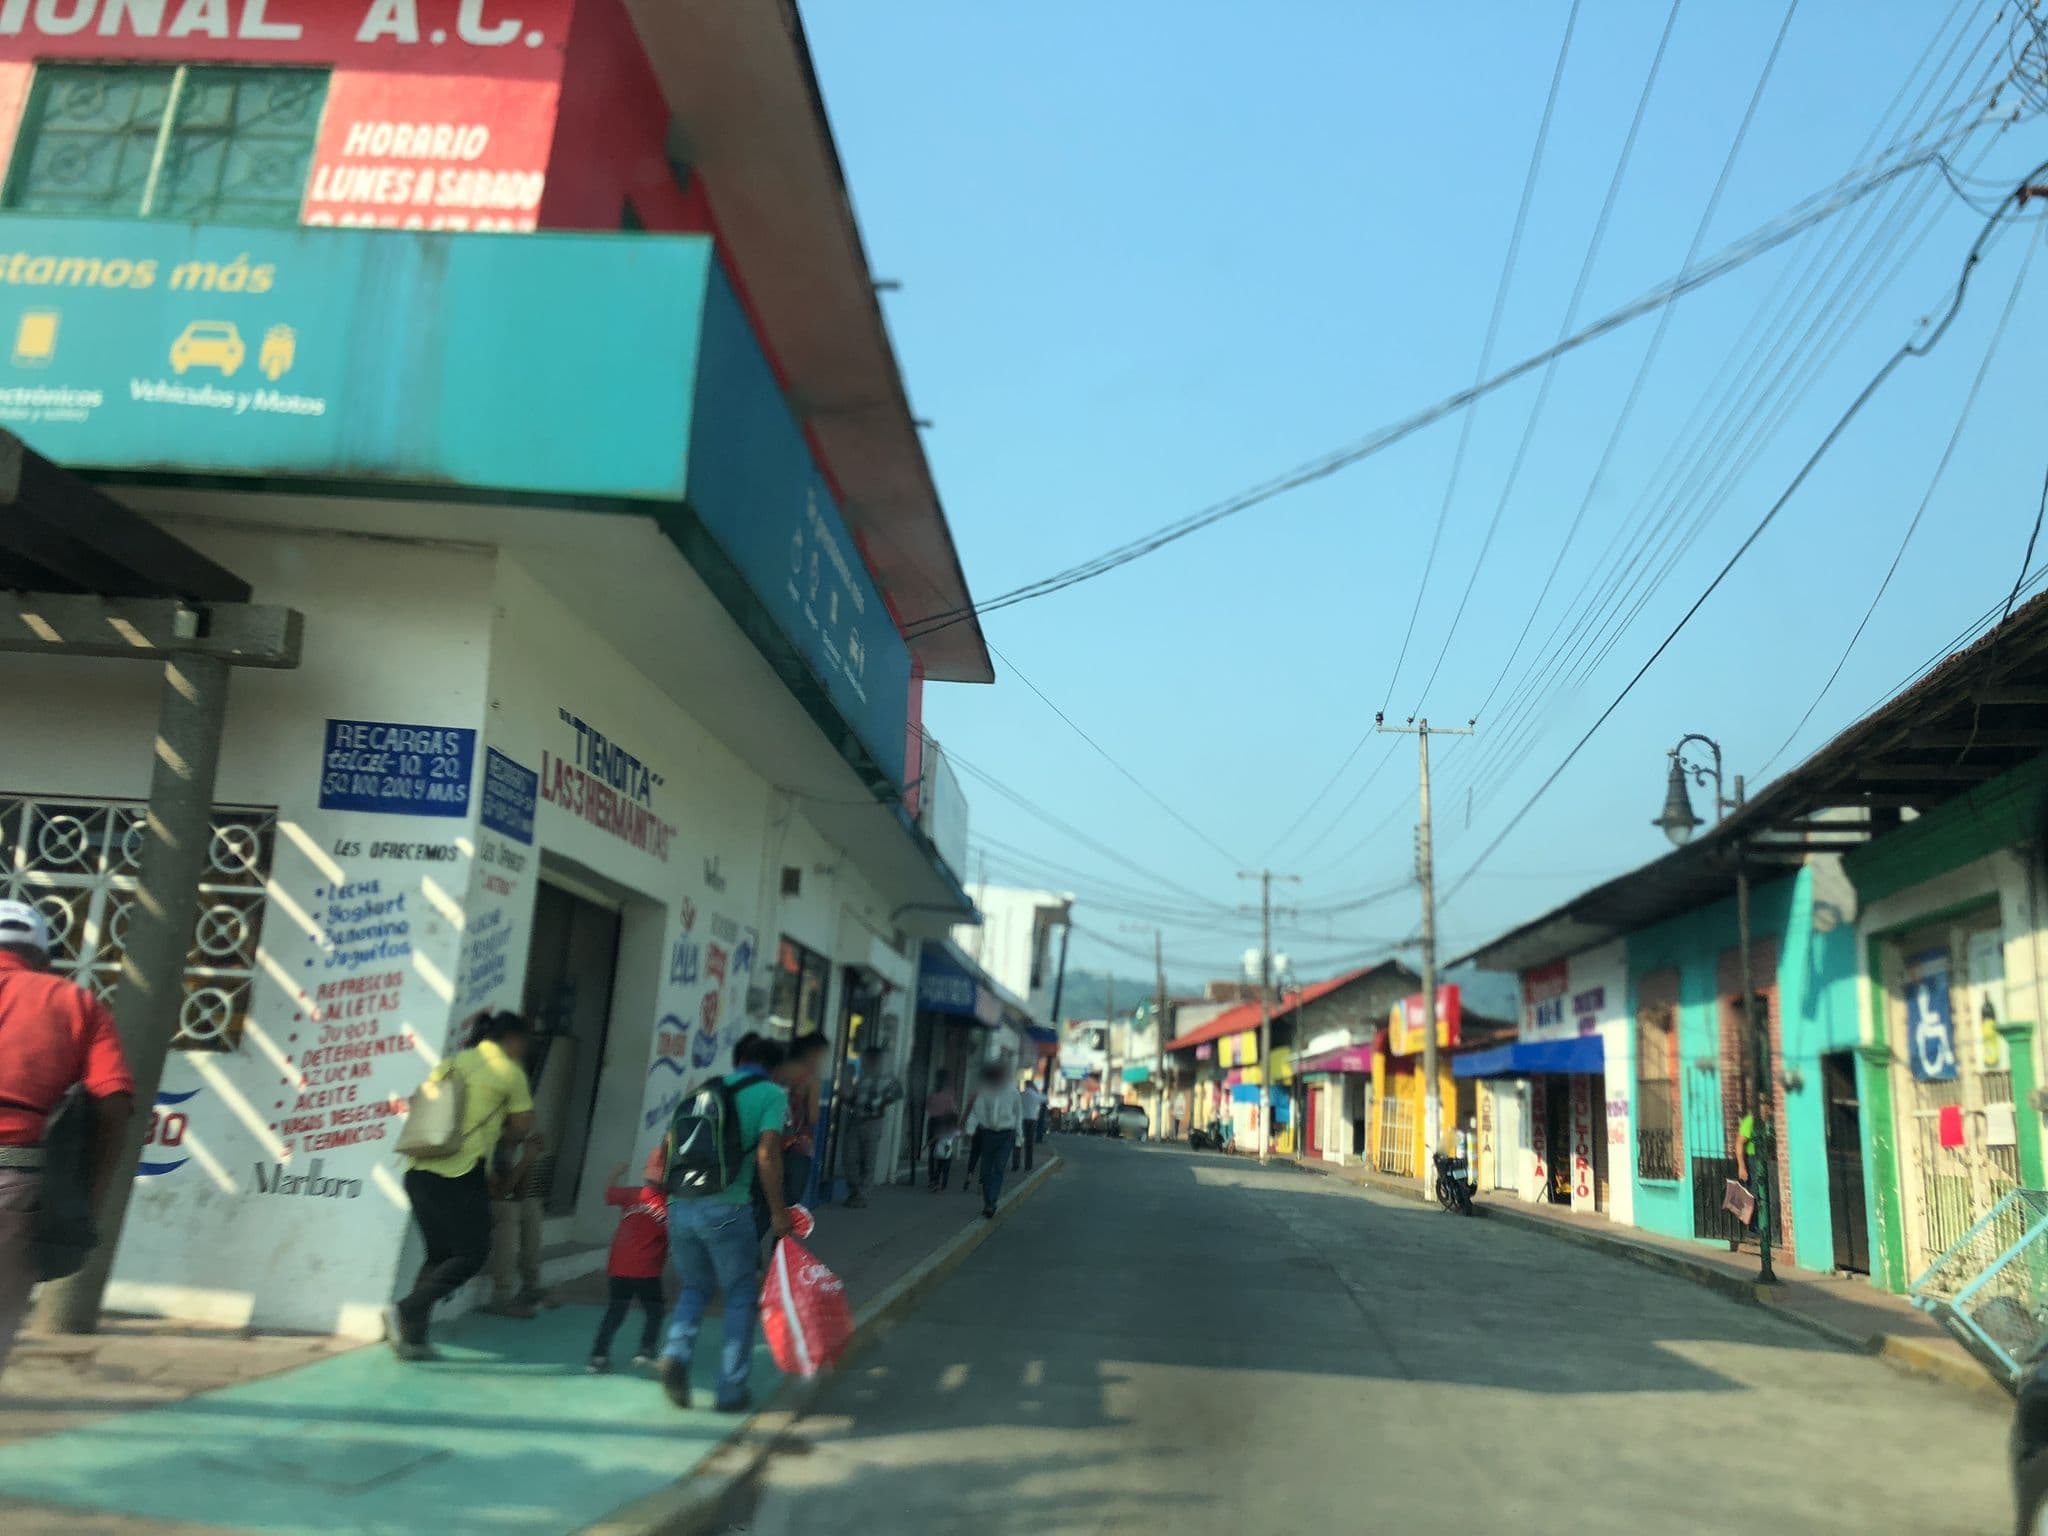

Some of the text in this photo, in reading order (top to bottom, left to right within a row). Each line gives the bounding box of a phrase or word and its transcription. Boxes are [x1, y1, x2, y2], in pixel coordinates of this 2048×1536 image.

[343, 121, 491, 161] HORARIO
[311, 164, 413, 203] LUNES
[411, 166, 436, 206] A
[169, 250, 276, 294] más
[335, 723, 460, 756] RECARGAS
[426, 782, 467, 803] MAS
[369, 841, 459, 862] OFRECEMOS
[328, 880, 380, 901] LECHE
[300, 1033, 416, 1069] DETERGENTES
[293, 1085, 358, 1113] ACEITE
